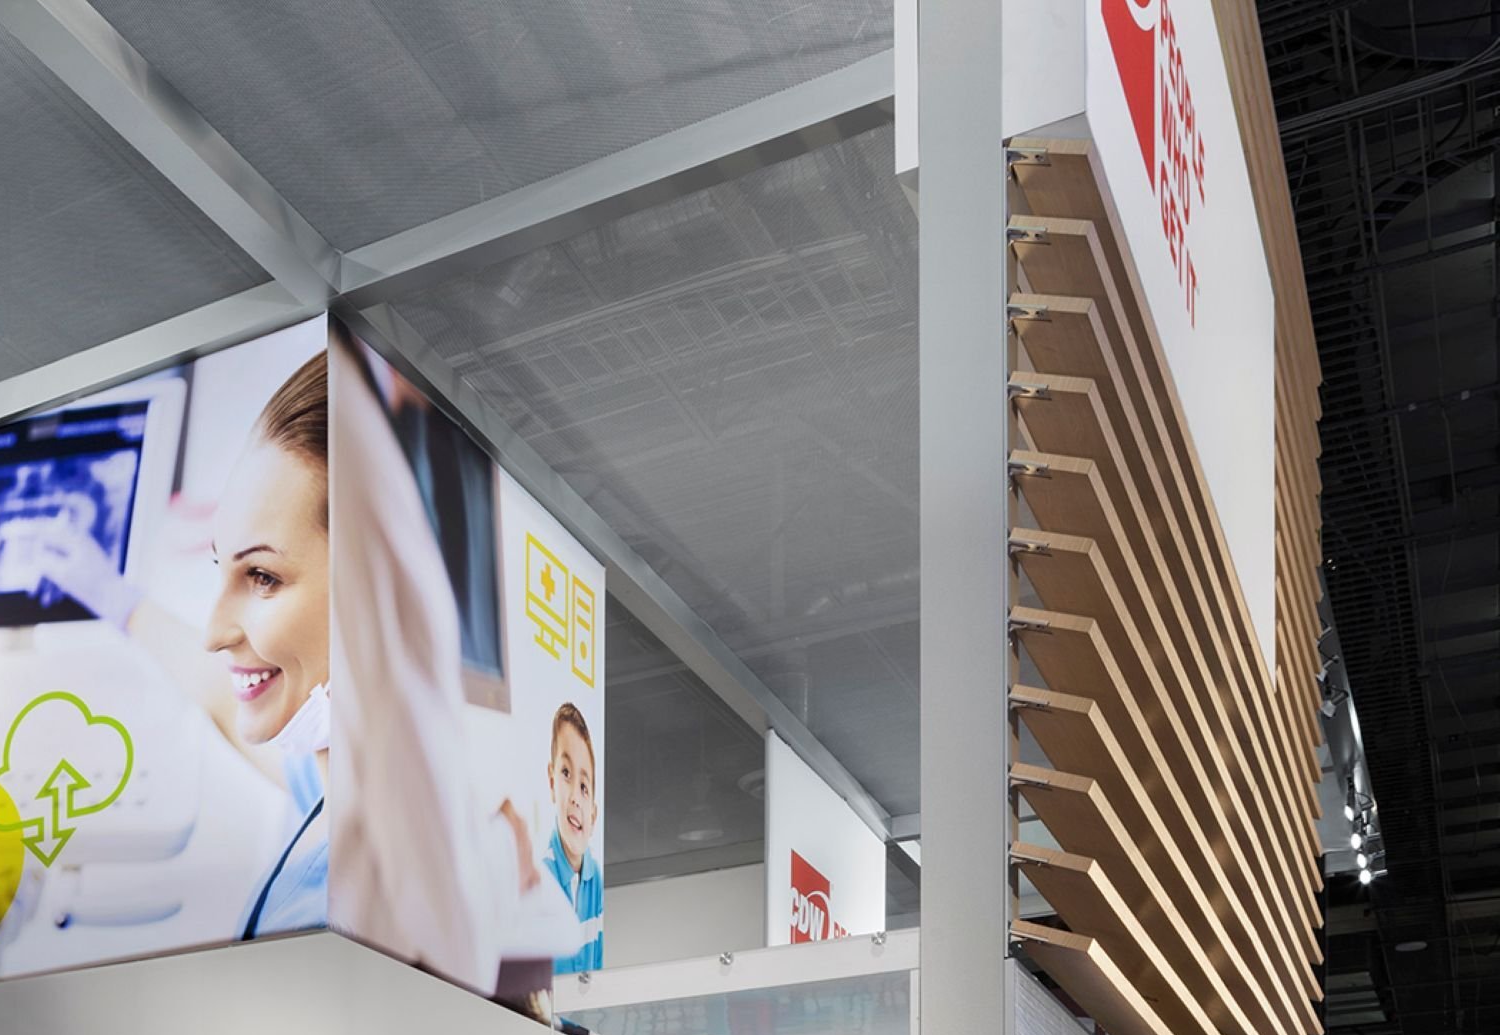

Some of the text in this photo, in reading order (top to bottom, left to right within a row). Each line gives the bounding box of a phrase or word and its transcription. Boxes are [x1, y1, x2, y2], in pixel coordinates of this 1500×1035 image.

[1160, 63, 1191, 226] WHO
[1160, 160, 1197, 331] GET IT
[790, 887, 825, 942] CDW
